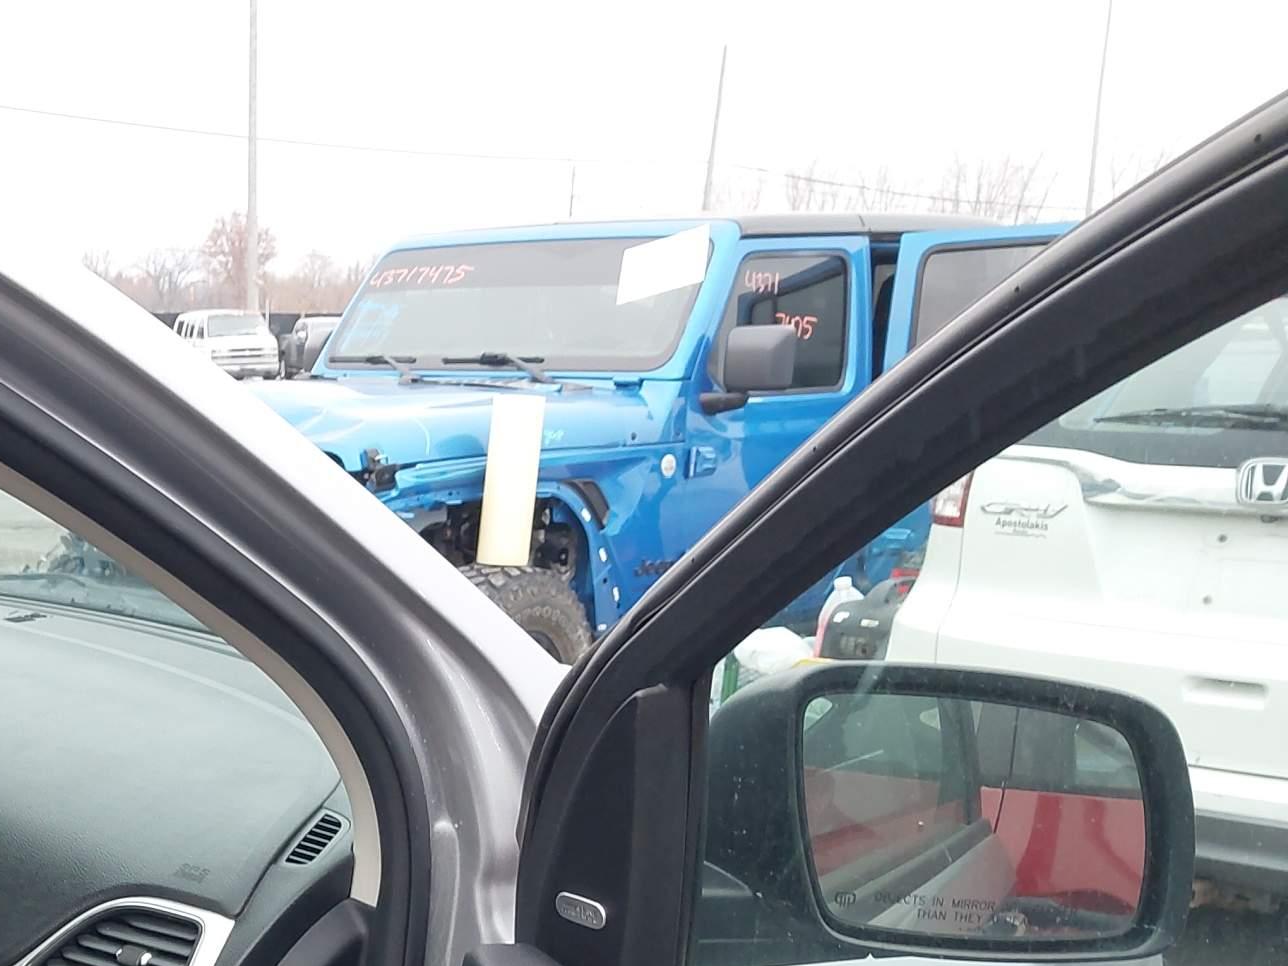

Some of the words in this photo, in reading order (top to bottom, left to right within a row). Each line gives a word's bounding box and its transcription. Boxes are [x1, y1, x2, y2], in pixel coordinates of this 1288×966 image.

[995, 516, 1049, 532] Apostolakis
[931, 895, 945, 908] IN
[951, 899, 996, 912] MIRROR
[916, 908, 947, 921] THAN
[953, 911, 983, 923] THEY
